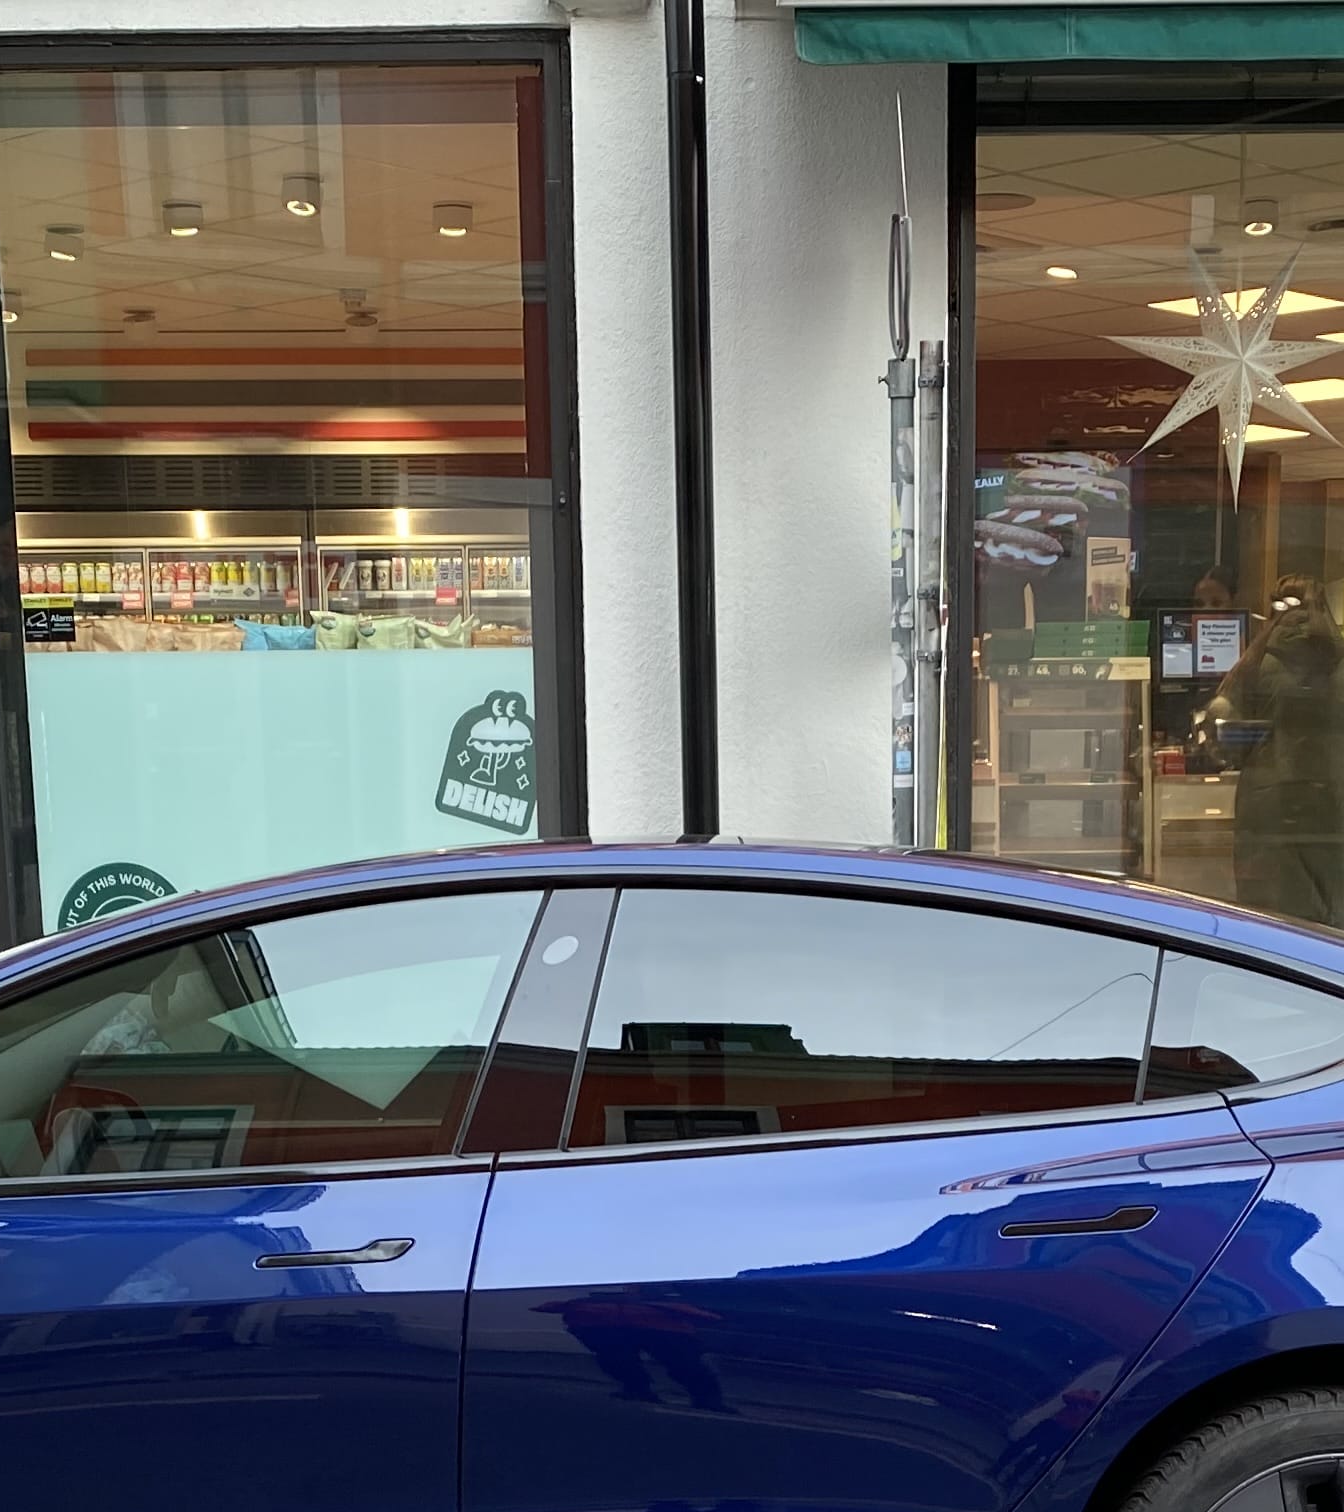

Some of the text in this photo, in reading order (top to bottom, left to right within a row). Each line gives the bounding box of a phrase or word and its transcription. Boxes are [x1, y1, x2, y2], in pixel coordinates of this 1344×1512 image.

[975, 475, 1004, 488] EALLY
[442, 779, 528, 827] DELISH
[74, 890, 88, 909] OF
[87, 875, 117, 894] THIS
[119, 873, 165, 898] WORLD
